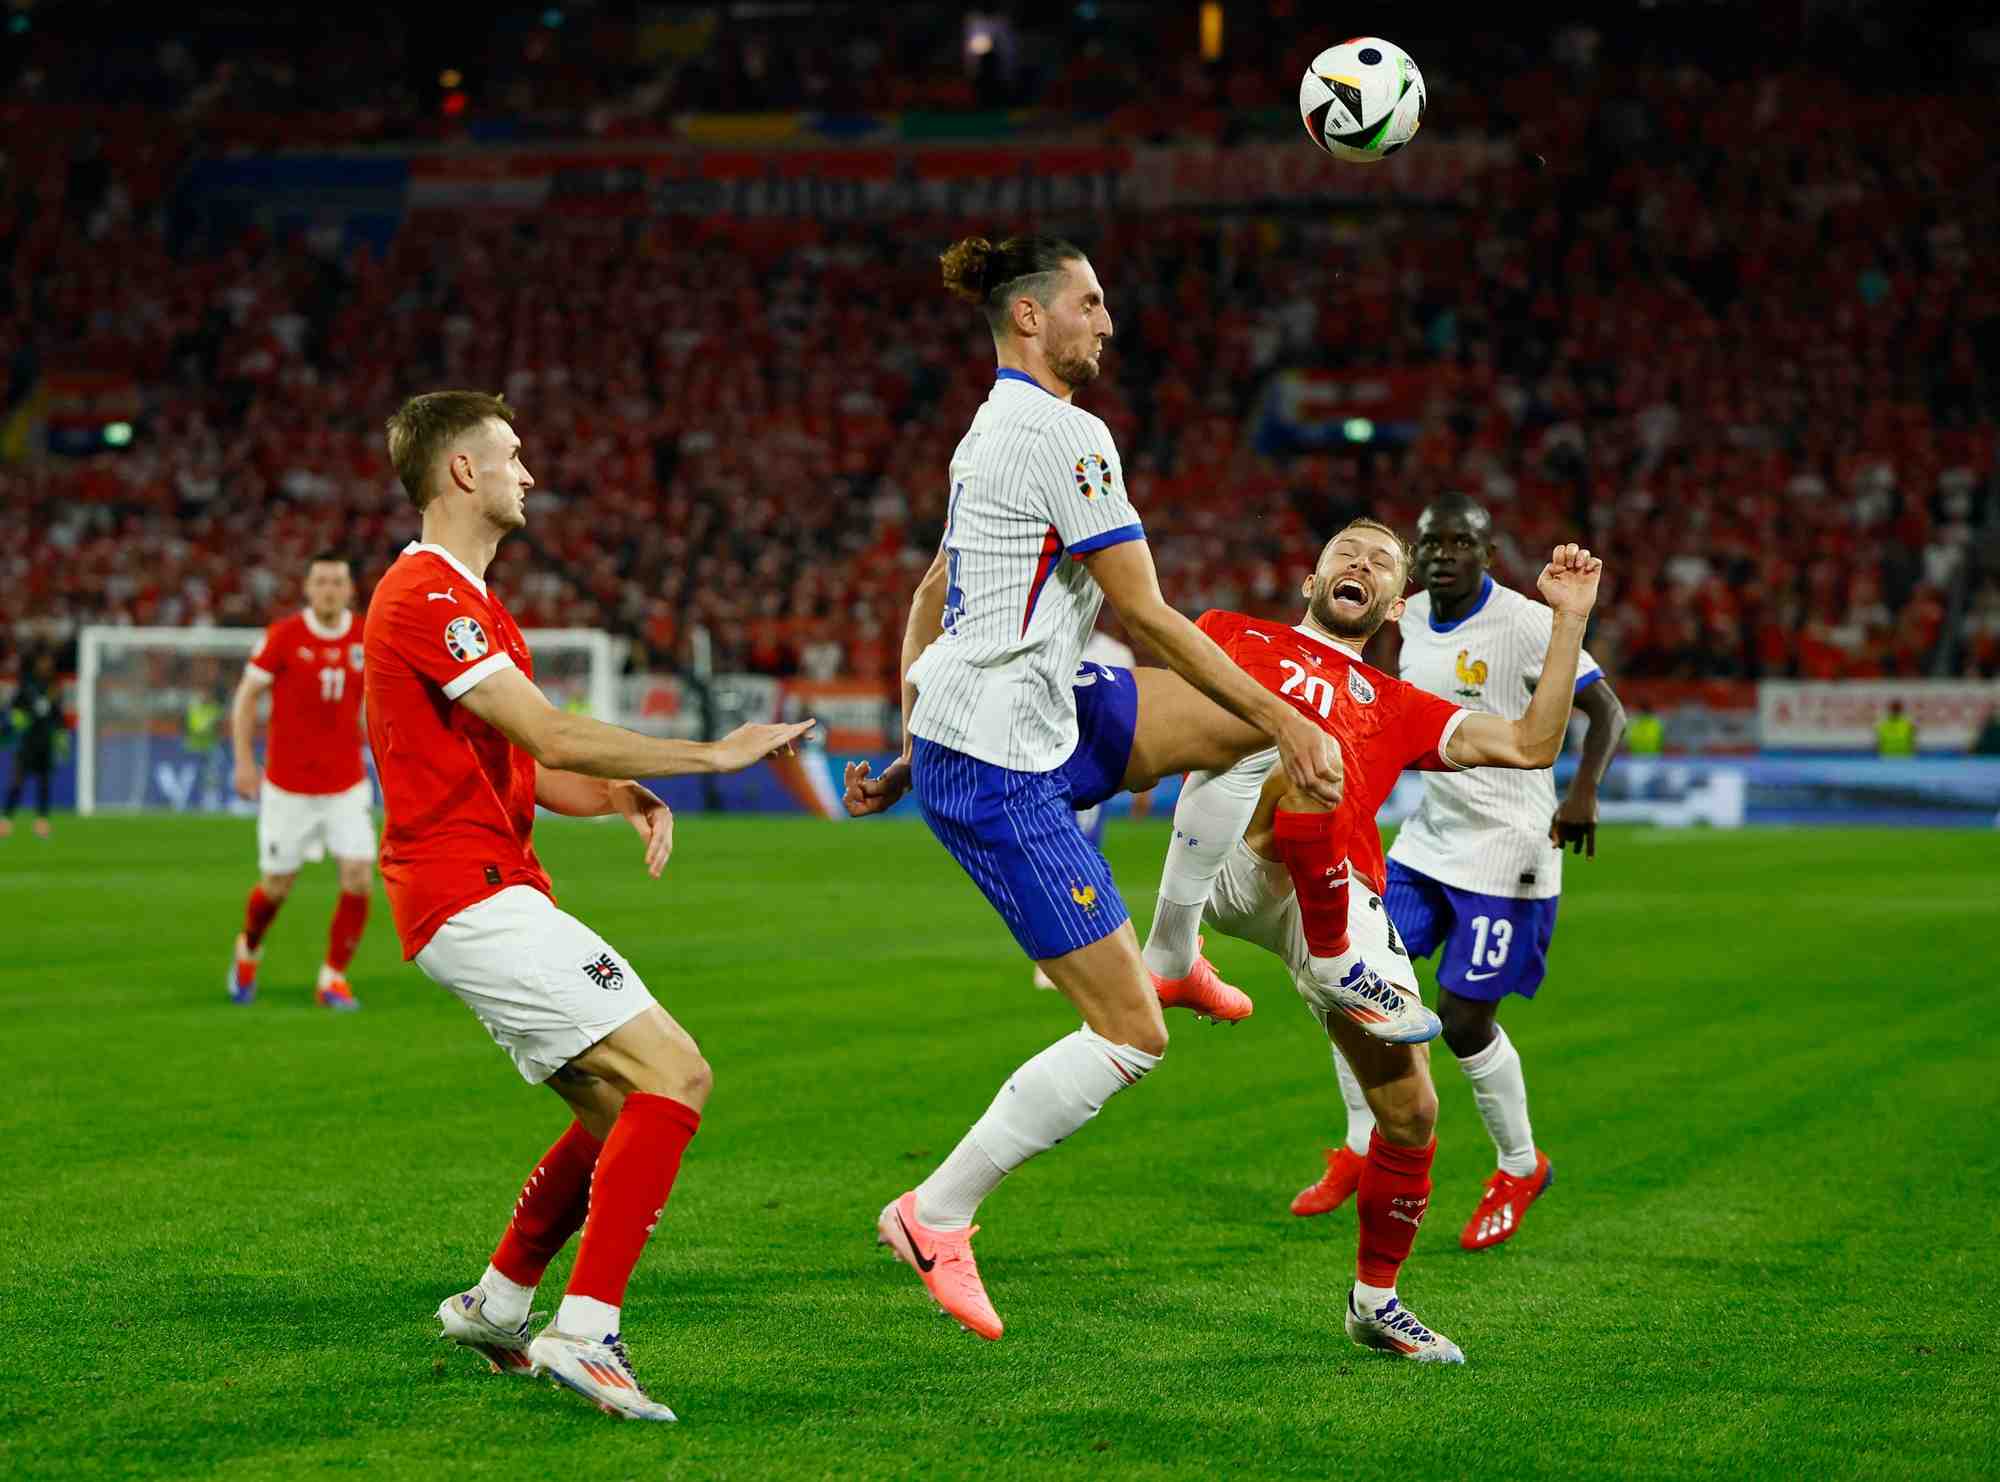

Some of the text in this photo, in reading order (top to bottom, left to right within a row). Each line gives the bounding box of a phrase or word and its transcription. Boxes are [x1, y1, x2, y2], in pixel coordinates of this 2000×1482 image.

[319, 666, 346, 703] 11
[1279, 659, 1335, 719] 20
[1471, 915, 1513, 968] 13
